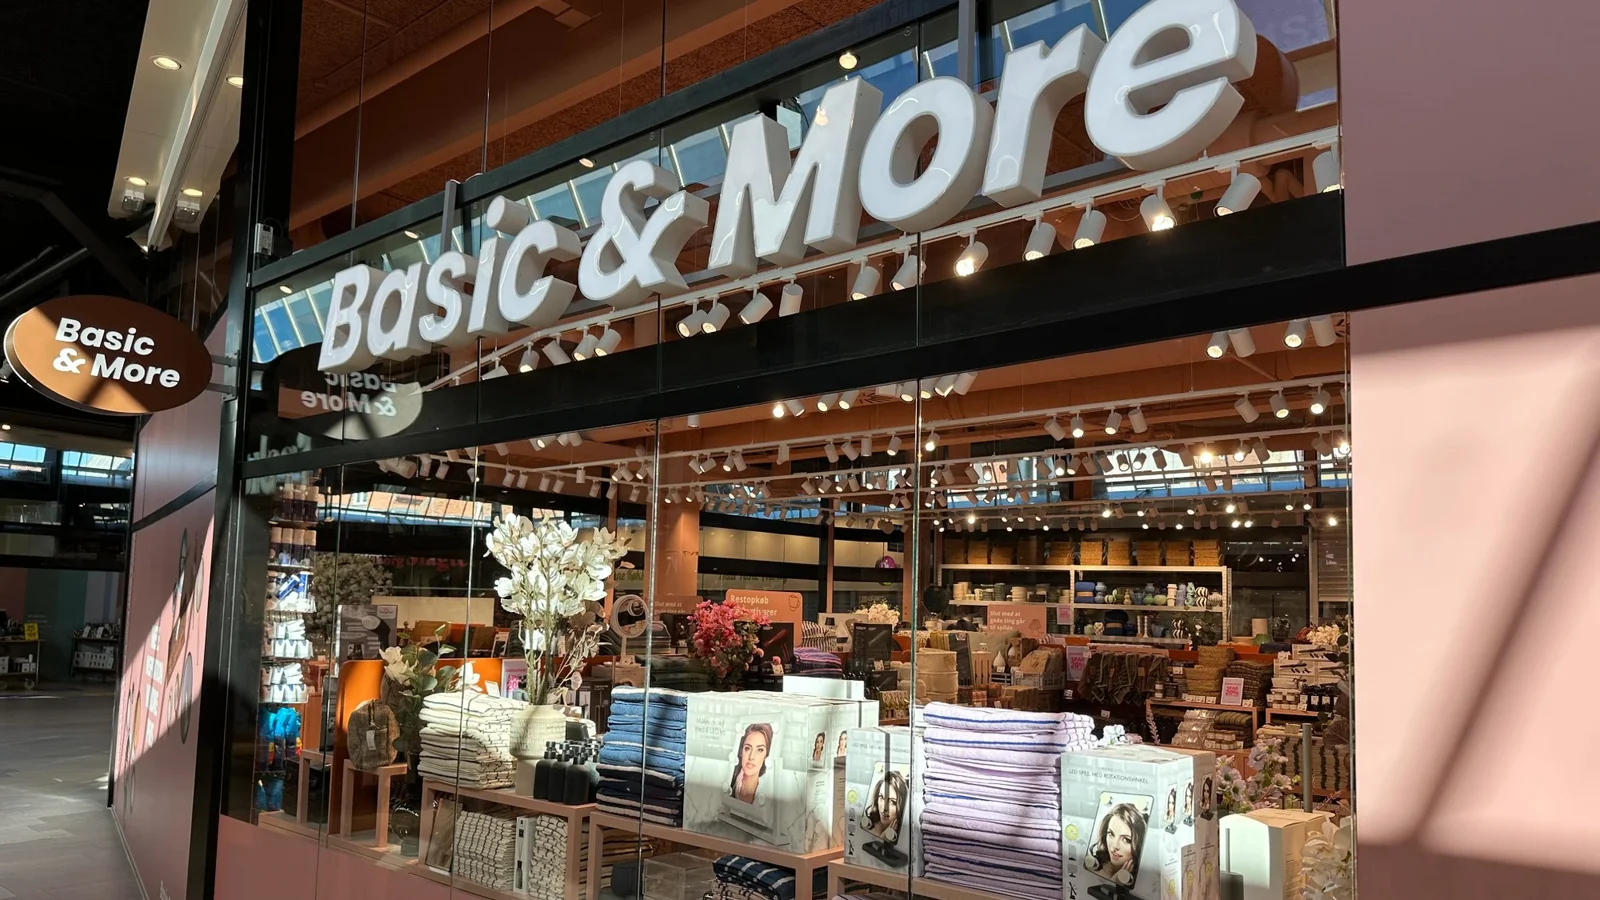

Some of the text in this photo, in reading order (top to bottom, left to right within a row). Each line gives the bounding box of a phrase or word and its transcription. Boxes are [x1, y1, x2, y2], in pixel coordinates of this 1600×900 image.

[318, 0, 1255, 372] Basic & More
[55, 317, 155, 356] Basic
[53, 348, 181, 388] & More
[730, 595, 770, 606] Restopkøb
